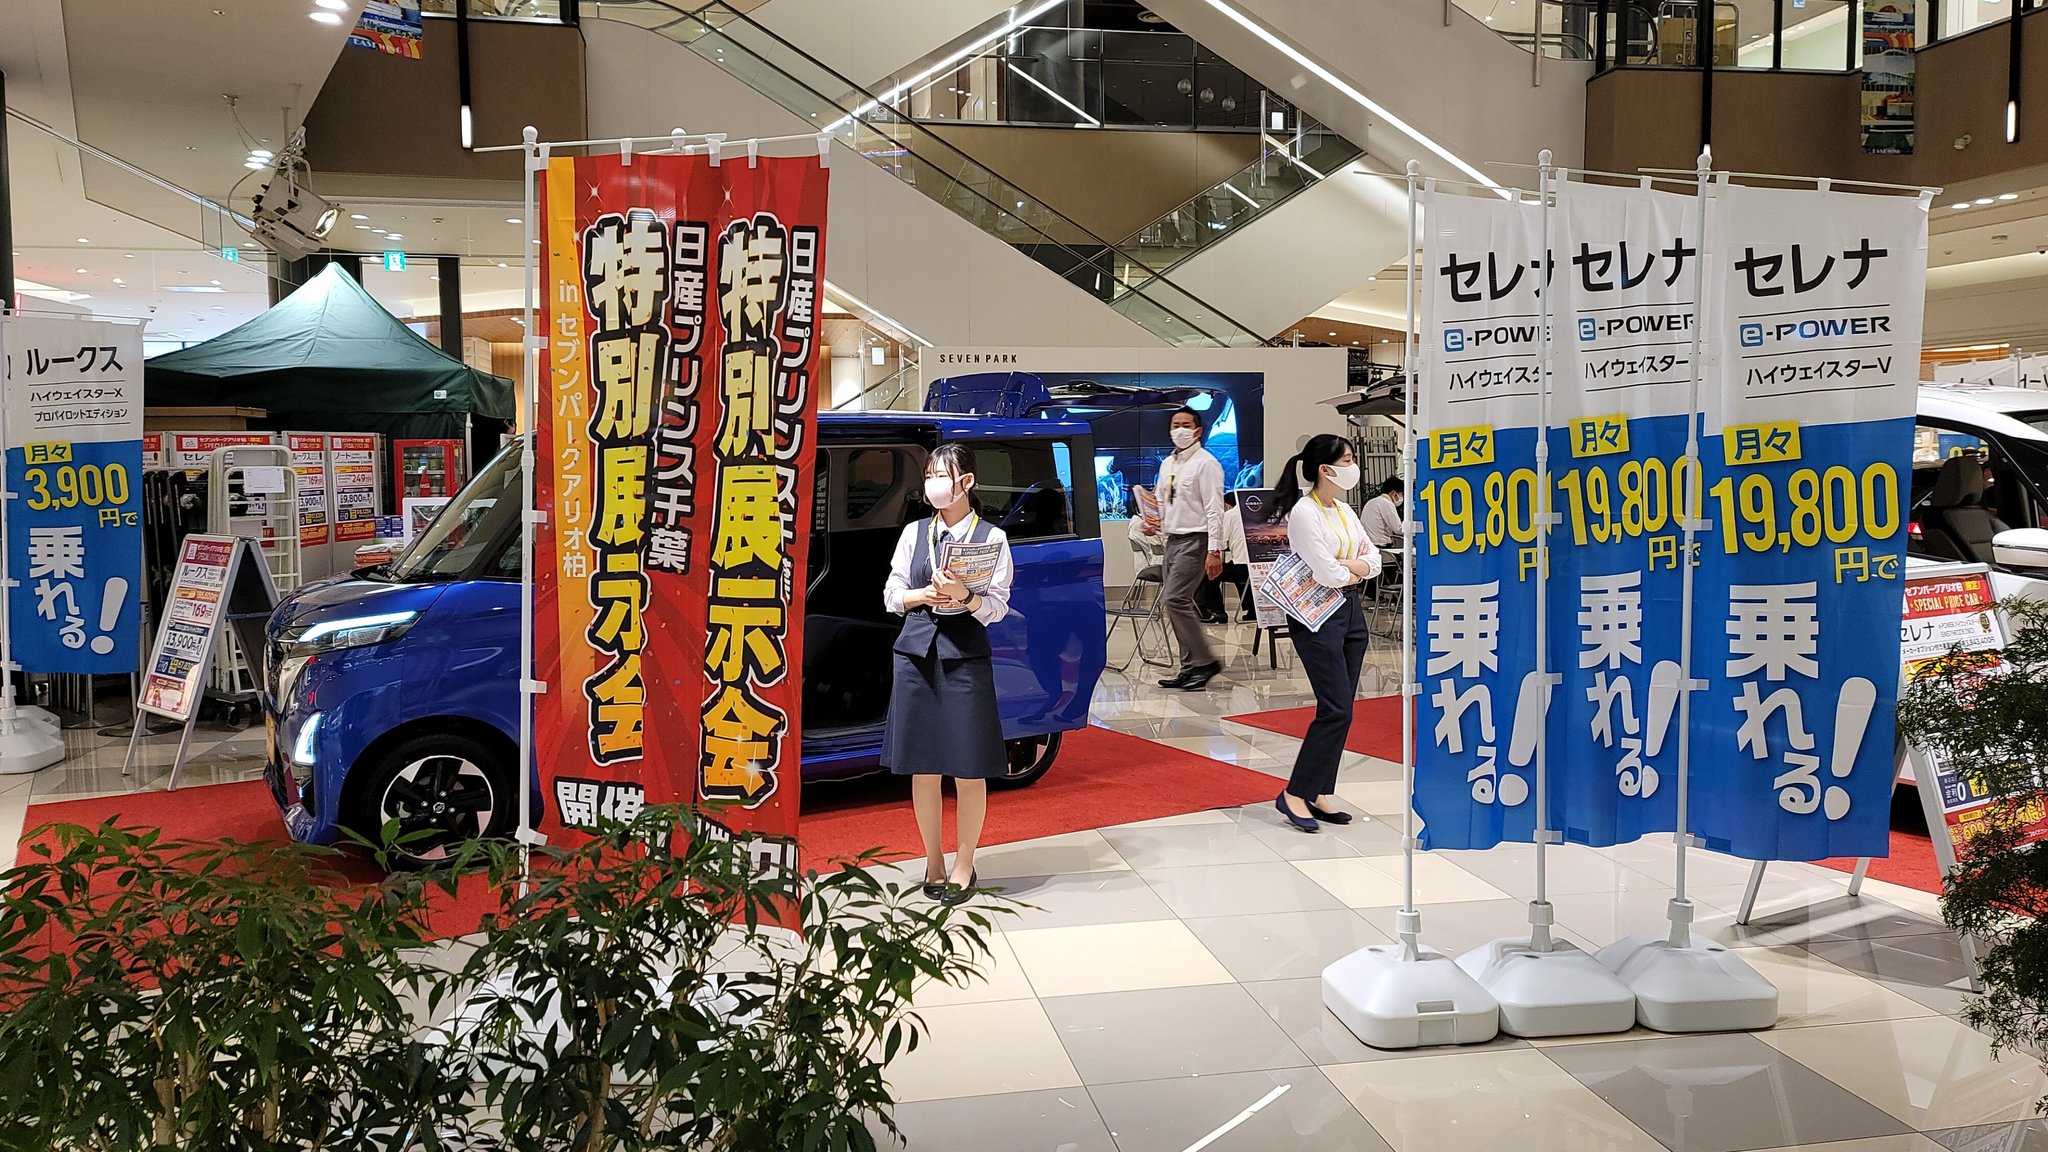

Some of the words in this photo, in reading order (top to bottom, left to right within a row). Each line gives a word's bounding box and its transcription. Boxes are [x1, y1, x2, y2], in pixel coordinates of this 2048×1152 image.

[1572, 237, 1697, 293] セレナ
[1734, 238, 1889, 298] セレナ
[559, 279, 578, 303] in
[1739, 315, 1892, 347] e-POWER
[26, 346, 124, 376] ルークス
[939, 353, 980, 364] SEVEN
[985, 353, 1017, 364] PARK
[1746, 356, 1892, 386] ハイウェイスターV
[30, 387, 124, 402] ハイウェイスターX
[648, 225, 706, 571] 日産プリンス千葉
[34, 408, 128, 423] プロパイロットエディション
[557, 312, 587, 578] セブンパークアリオ柏
[1437, 431, 1489, 464] 月々
[1580, 419, 1621, 453] 月々
[1734, 427, 1792, 461] 月々
[31, 443, 68, 462] 月々
[24, 463, 130, 511] 3,900
[352, 473, 366, 483] 249
[699, 223, 783, 797] 特別展示会
[1557, 456, 1703, 547] 19,800
[1709, 462, 1900, 555] 19,800
[98, 507, 139, 528] 円で
[181, 565, 209, 579] ルークス
[1834, 546, 1900, 584] 円で
[192, 603, 207, 618] 169
[1913, 596, 1945, 613] SPECIAL
[1965, 592, 1980, 606] CAR
[1901, 622, 1935, 643] セレナ
